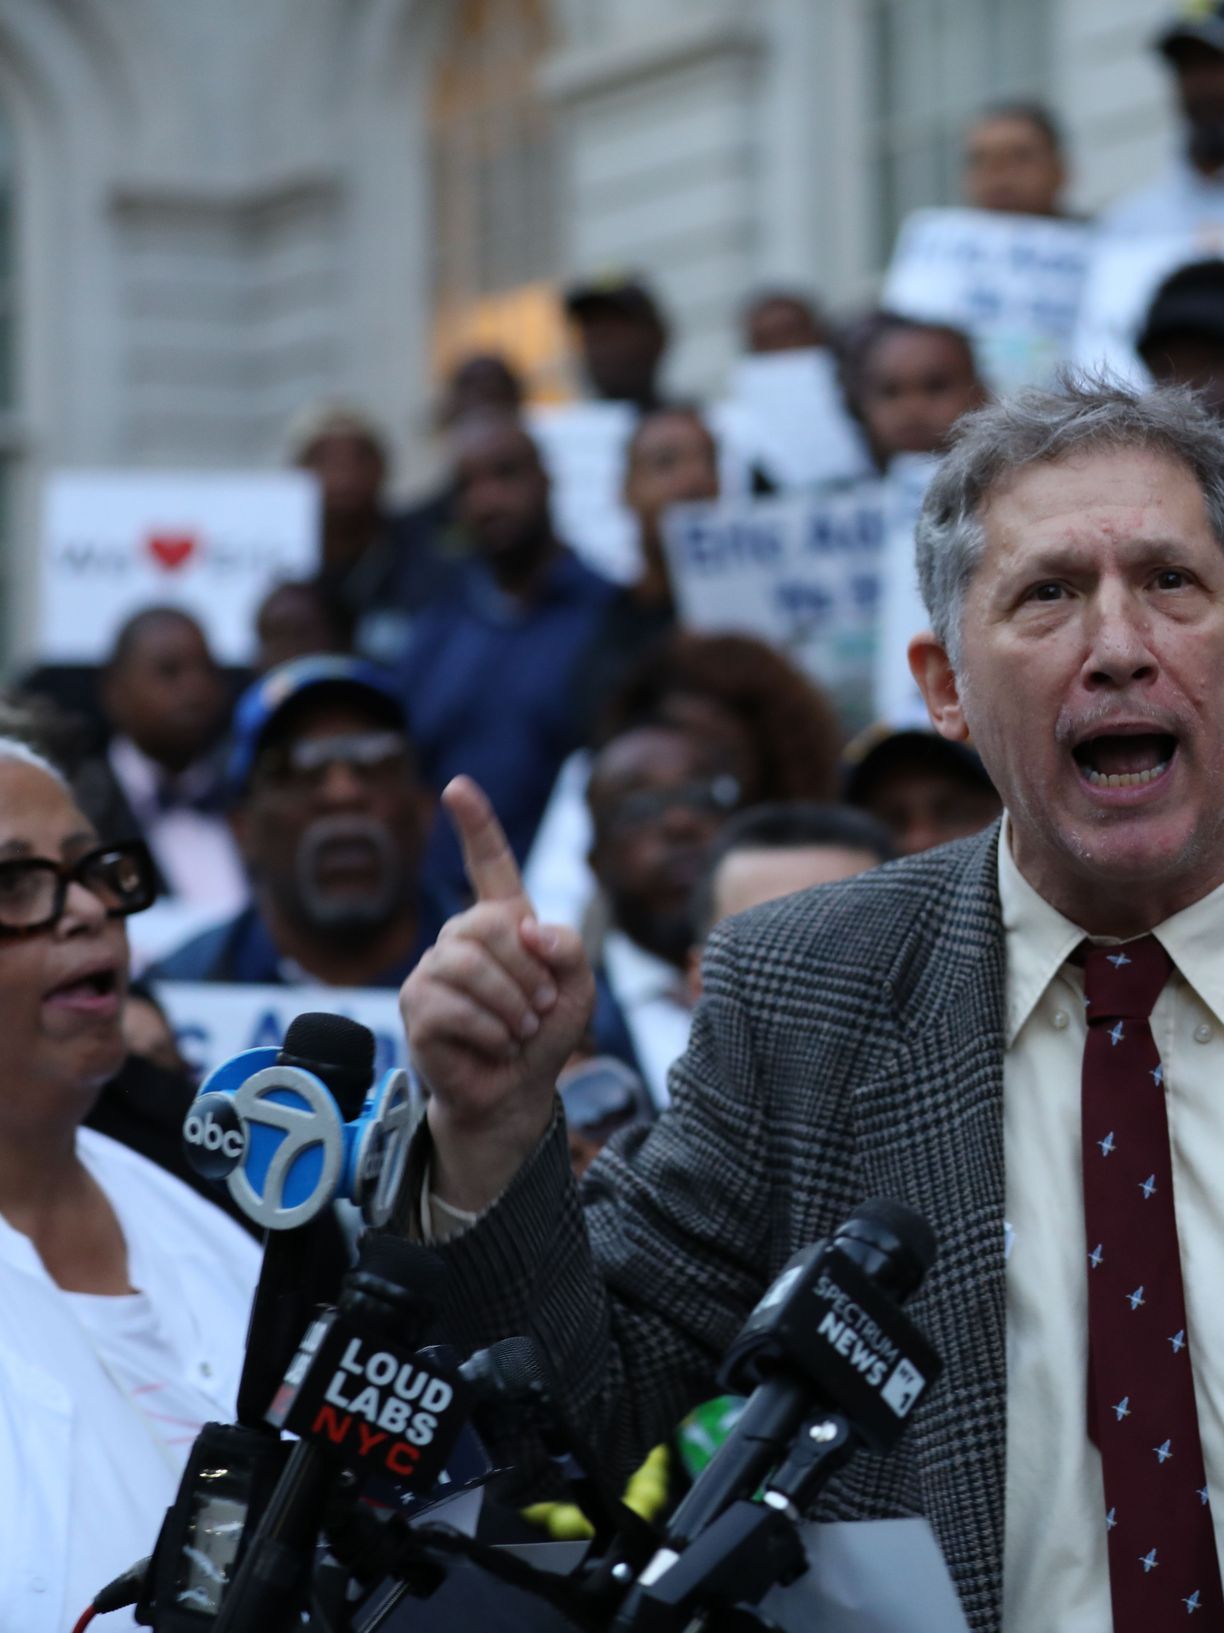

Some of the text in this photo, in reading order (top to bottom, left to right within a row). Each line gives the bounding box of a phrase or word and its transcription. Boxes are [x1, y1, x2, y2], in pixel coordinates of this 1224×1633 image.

[183, 1111, 247, 1158] abc
[812, 1274, 899, 1366] SPECTRUM
[816, 1310, 889, 1387] NEWS
[323, 1370, 439, 1447] LABS
[339, 1337, 454, 1414] LOUD
[311, 1405, 421, 1476] NYC
